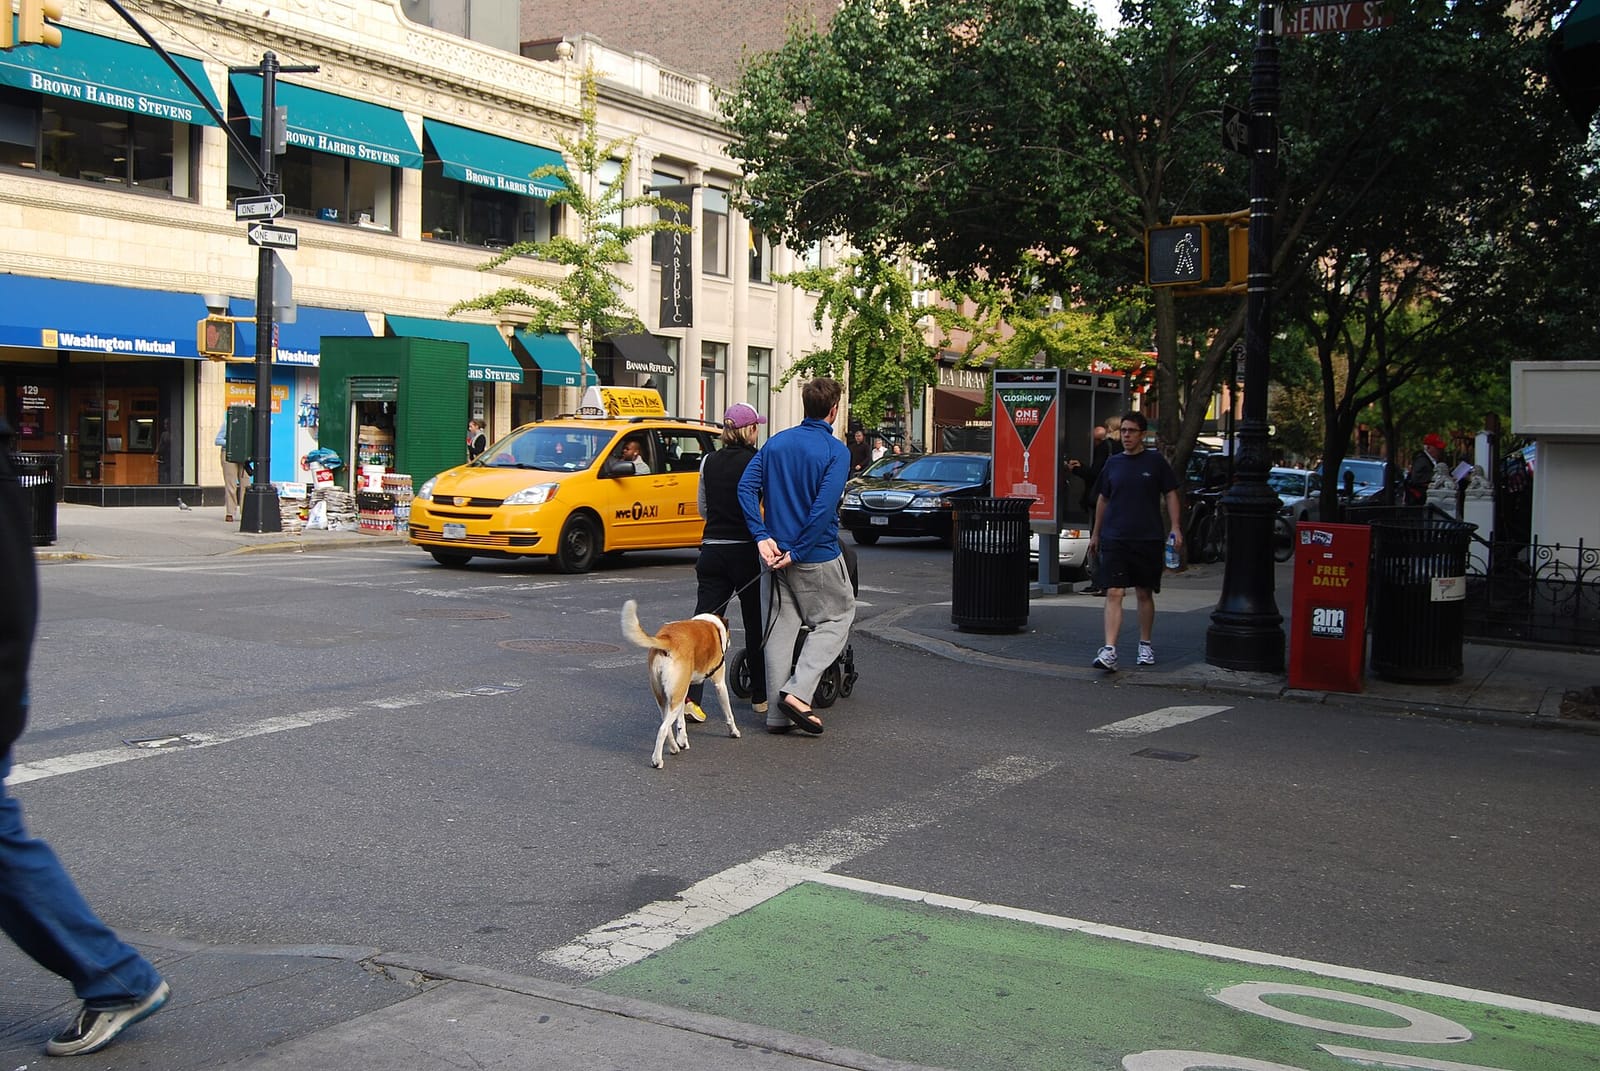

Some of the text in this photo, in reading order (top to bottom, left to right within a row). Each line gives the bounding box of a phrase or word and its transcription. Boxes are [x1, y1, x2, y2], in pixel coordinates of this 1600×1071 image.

[1286, 4, 1352, 33] HENRY
[30, 72, 192, 121] BROWN HARRIS STEVENS
[286, 130, 400, 165] ROWN HARRIS STEVENS
[465, 168, 556, 198] BROWN HARRIS STEVE
[241, 202, 278, 214] ONE WAY
[254, 231, 292, 242] ONE WAY
[59, 333, 176, 354] Washington Mutual
[277, 350, 320, 366] Washing
[467, 367, 520, 381] RIS STEVENS
[625, 360, 674, 374] BANANA REPUBLIC
[22, 385, 39, 395] 129
[1003, 394, 1052, 402] CLOSING NOW
[1015, 410, 1038, 418] ONE
[615, 501, 658, 520] NYC TAXI
[1316, 565, 1346, 576] FREE
[1312, 576, 1350, 588] DAILY
[1313, 608, 1344, 627] am
